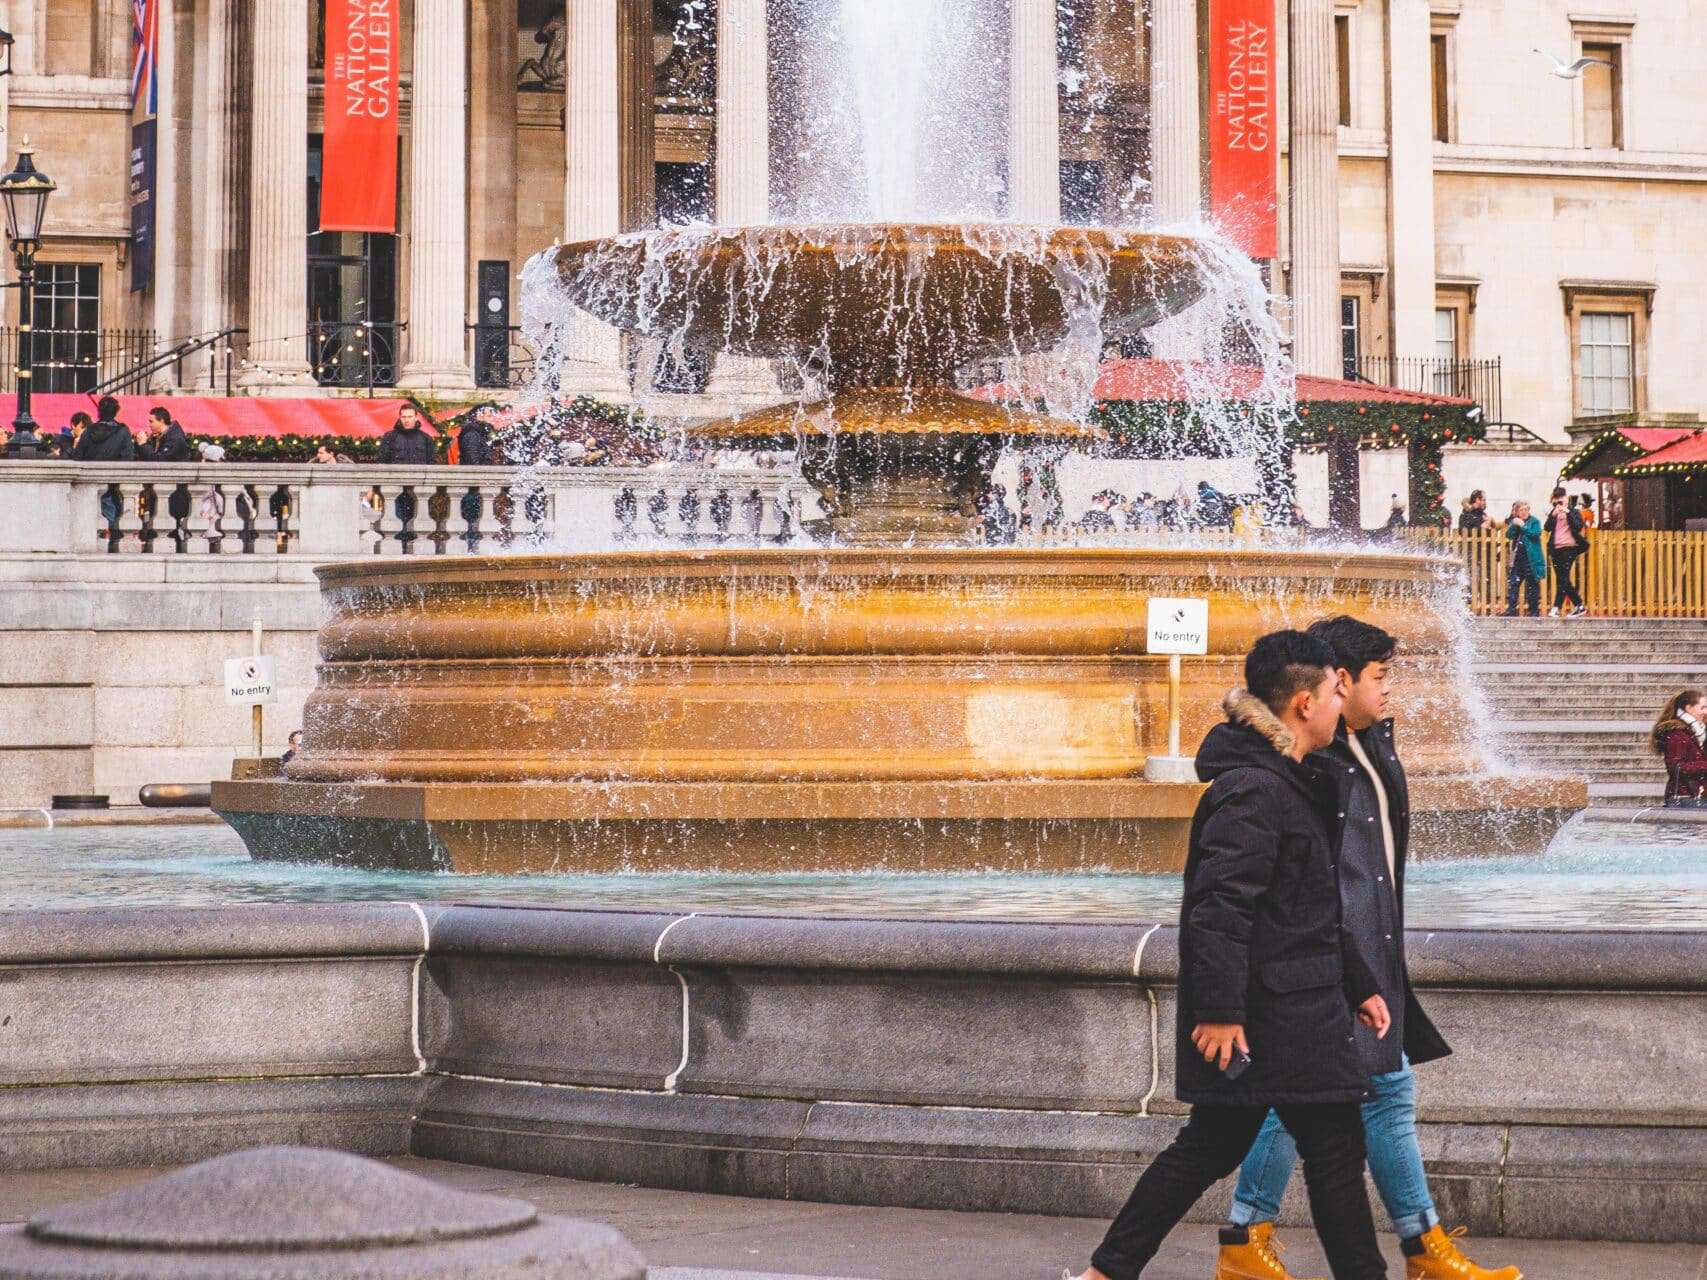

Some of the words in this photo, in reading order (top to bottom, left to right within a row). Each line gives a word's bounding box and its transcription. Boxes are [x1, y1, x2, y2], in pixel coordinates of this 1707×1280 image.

[334, 52, 345, 81] THE
[1228, 19, 1247, 150] NATIONAL
[1248, 21, 1269, 153] GALLERY
[1217, 90, 1227, 115] THE
[1154, 631, 1170, 641] No
[1173, 632, 1201, 644] entry
[231, 688, 245, 696] No
[247, 685, 272, 695] entry
